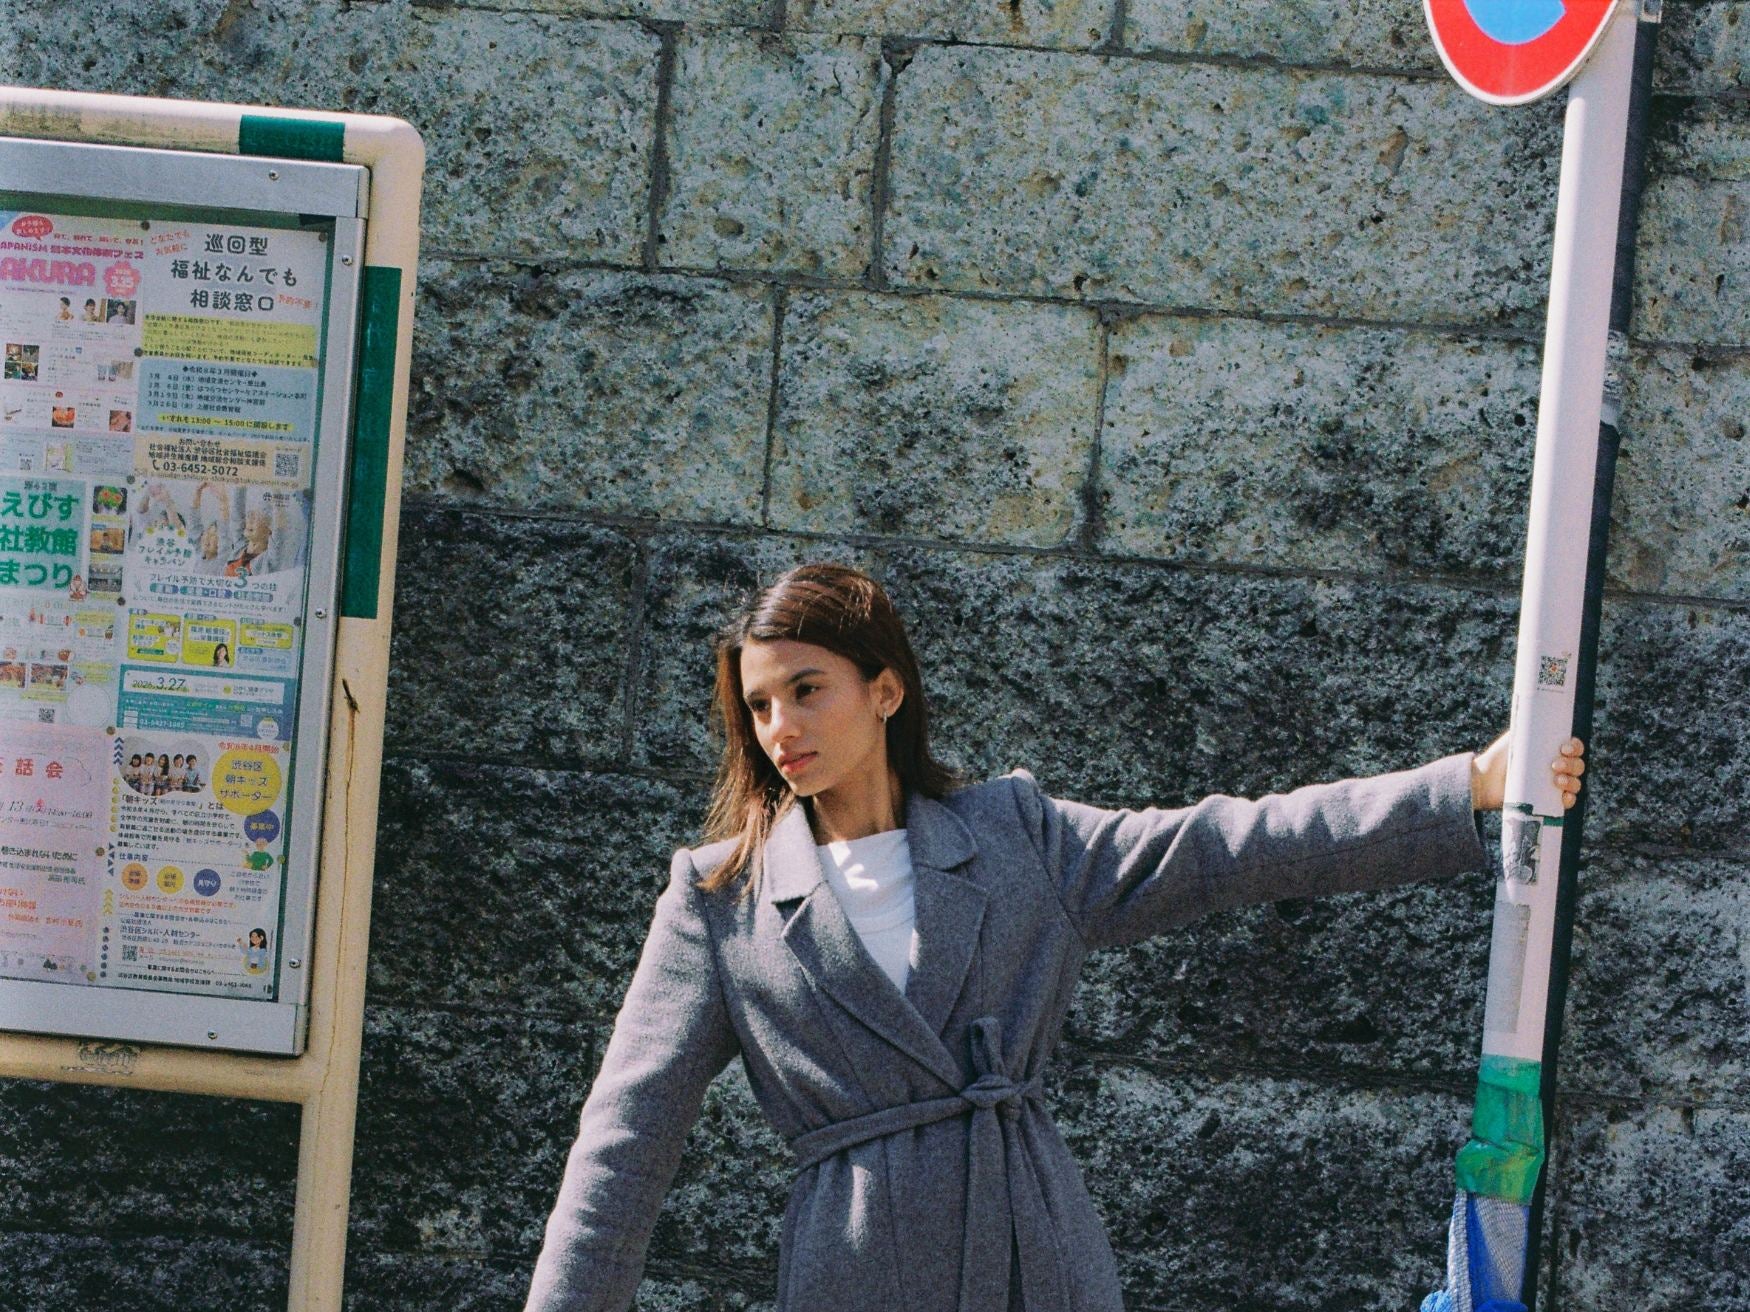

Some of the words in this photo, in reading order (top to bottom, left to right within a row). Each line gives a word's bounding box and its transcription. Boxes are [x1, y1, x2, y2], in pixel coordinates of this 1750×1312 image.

[204, 233, 268, 257] 巡回型
[170, 259, 297, 287] 福祉なんでも
[190, 288, 274, 312] 相談窓口
[149, 443, 192, 454] 社会福祉法人
[179, 439, 221, 448] お問い合わせ
[163, 461, 239, 477] 03-6452-5072
[1, 491, 80, 521] えびす
[0, 524, 78, 556] 社教館
[0, 559, 73, 589] まつり
[231, 759, 265, 772] 渋谷区
[225, 774, 269, 787] 朝キッズ
[219, 789, 273, 803] サポーター
[119, 853, 149, 863] 仕事内容
